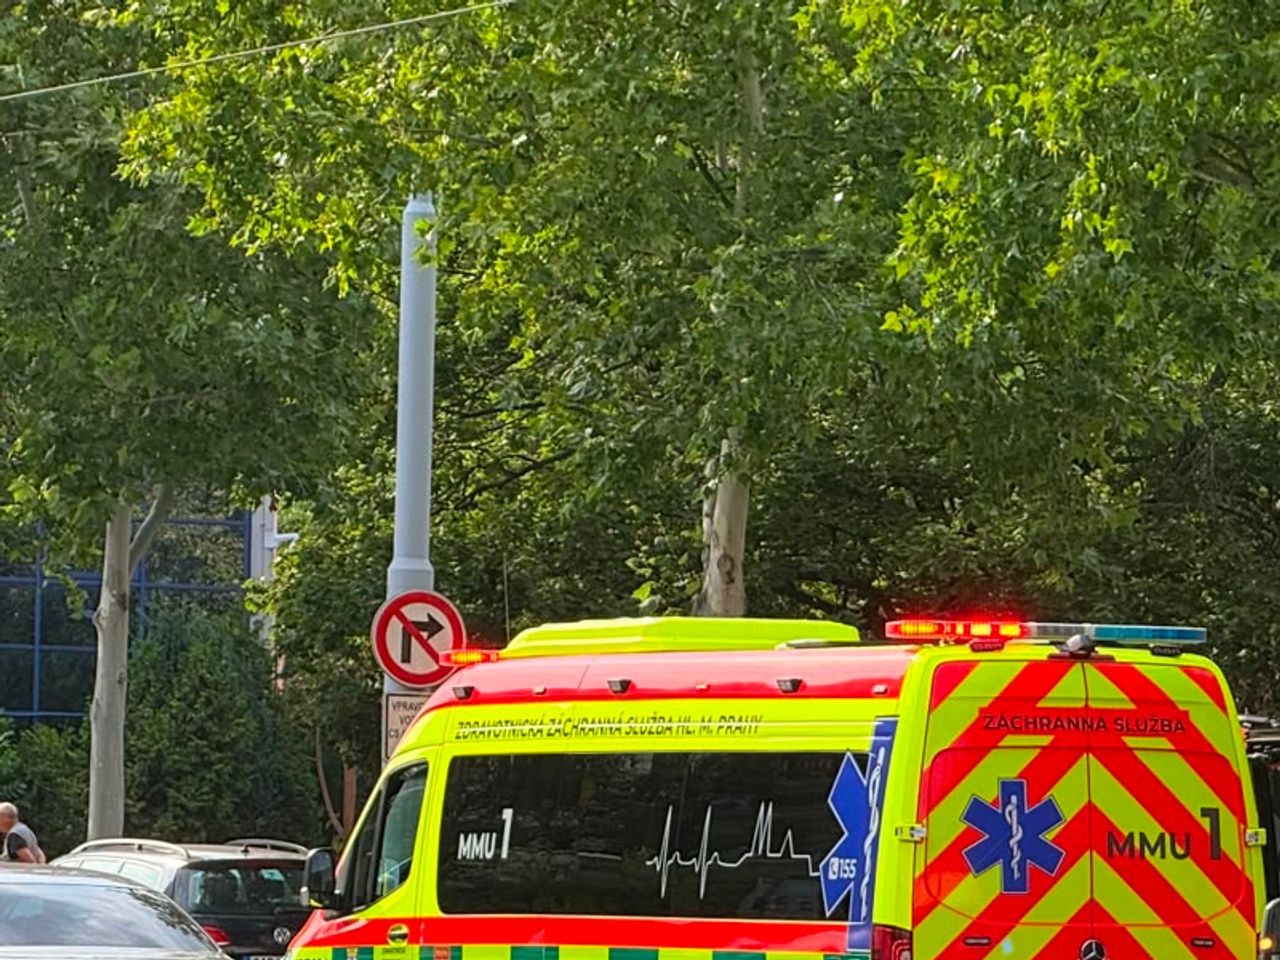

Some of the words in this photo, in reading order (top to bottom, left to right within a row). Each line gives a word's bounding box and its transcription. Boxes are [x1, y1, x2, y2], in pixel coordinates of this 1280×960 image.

[454, 715, 545, 740] ZDRAVOTNICKÁ
[547, 711, 624, 738] ZÁCHRANNÁ
[625, 711, 674, 736] SLUŽBA
[983, 710, 1108, 732] ZÁCHRANNÁ
[1113, 713, 1185, 734] SLUŽBA
[457, 831, 497, 860] MMU
[501, 807, 514, 859] 1
[1106, 831, 1191, 860] MMU
[1200, 806, 1220, 860] 1
[840, 858, 857, 879] 155
